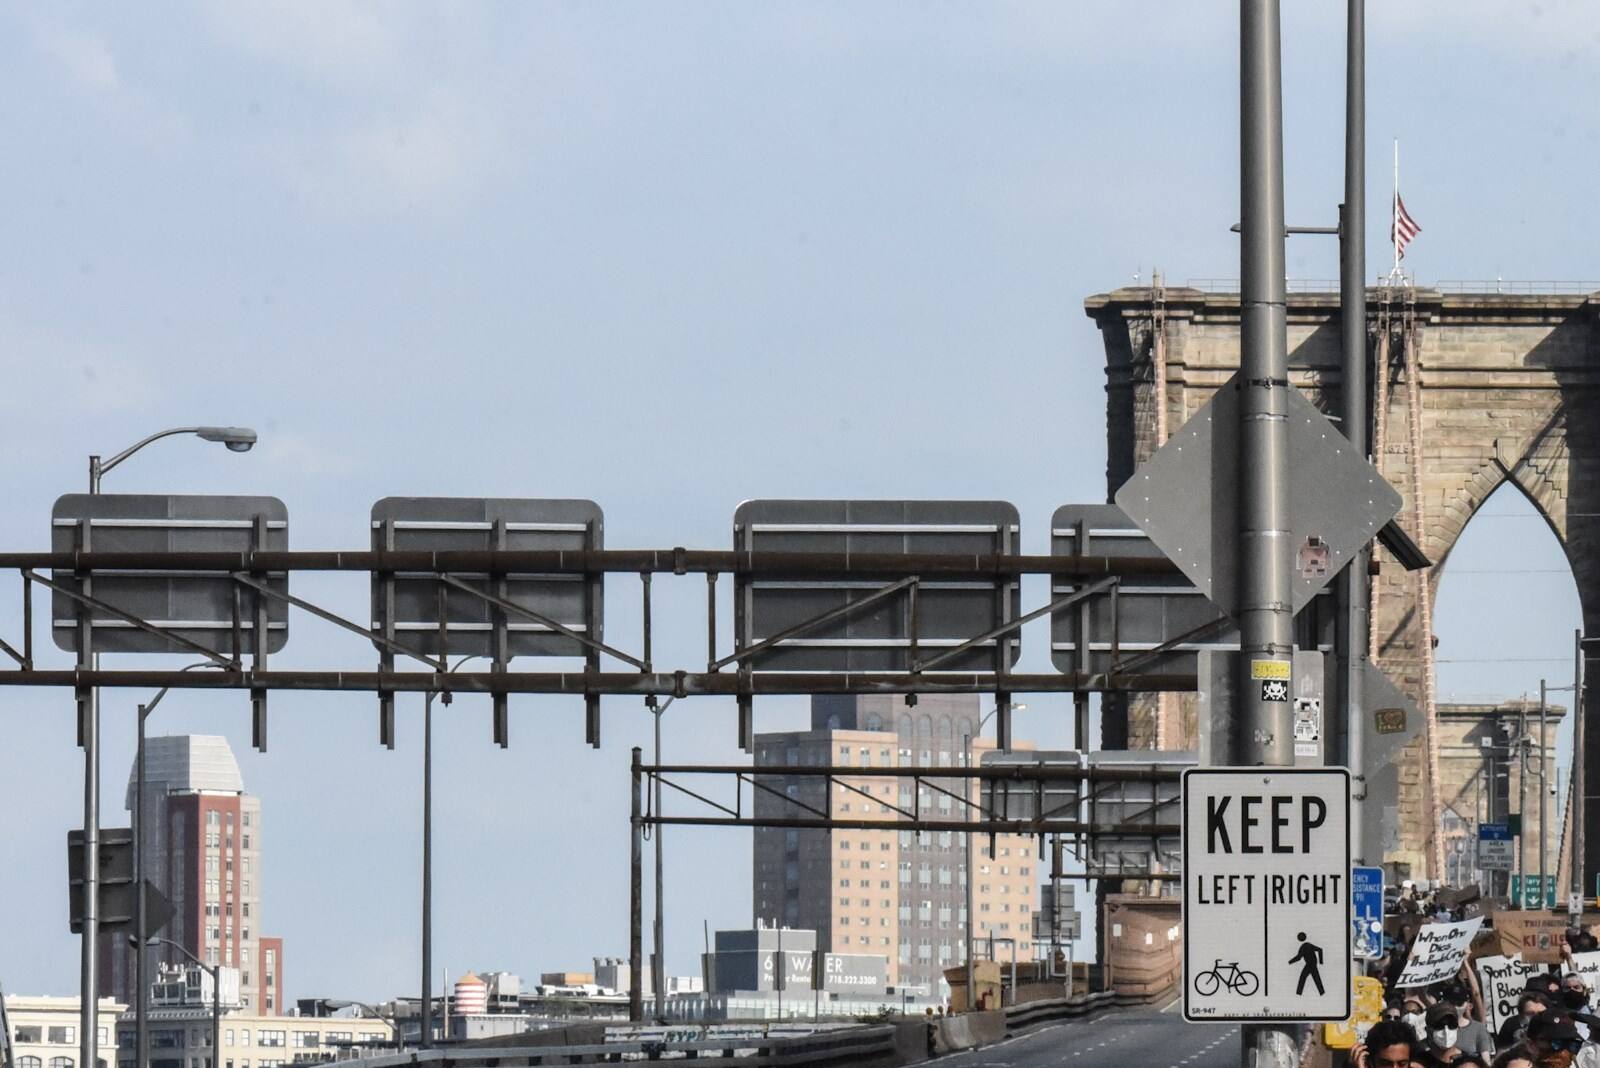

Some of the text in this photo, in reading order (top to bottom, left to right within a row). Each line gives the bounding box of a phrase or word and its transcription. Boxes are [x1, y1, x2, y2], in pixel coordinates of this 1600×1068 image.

[1207, 796, 1327, 854] KEEP
[1198, 875, 1255, 904] LEFT
[1272, 875, 1341, 904] RIGHT
[792, 956, 843, 973] WAER
[1483, 964, 1512, 979] Don't
[1576, 963, 1599, 974] Look
